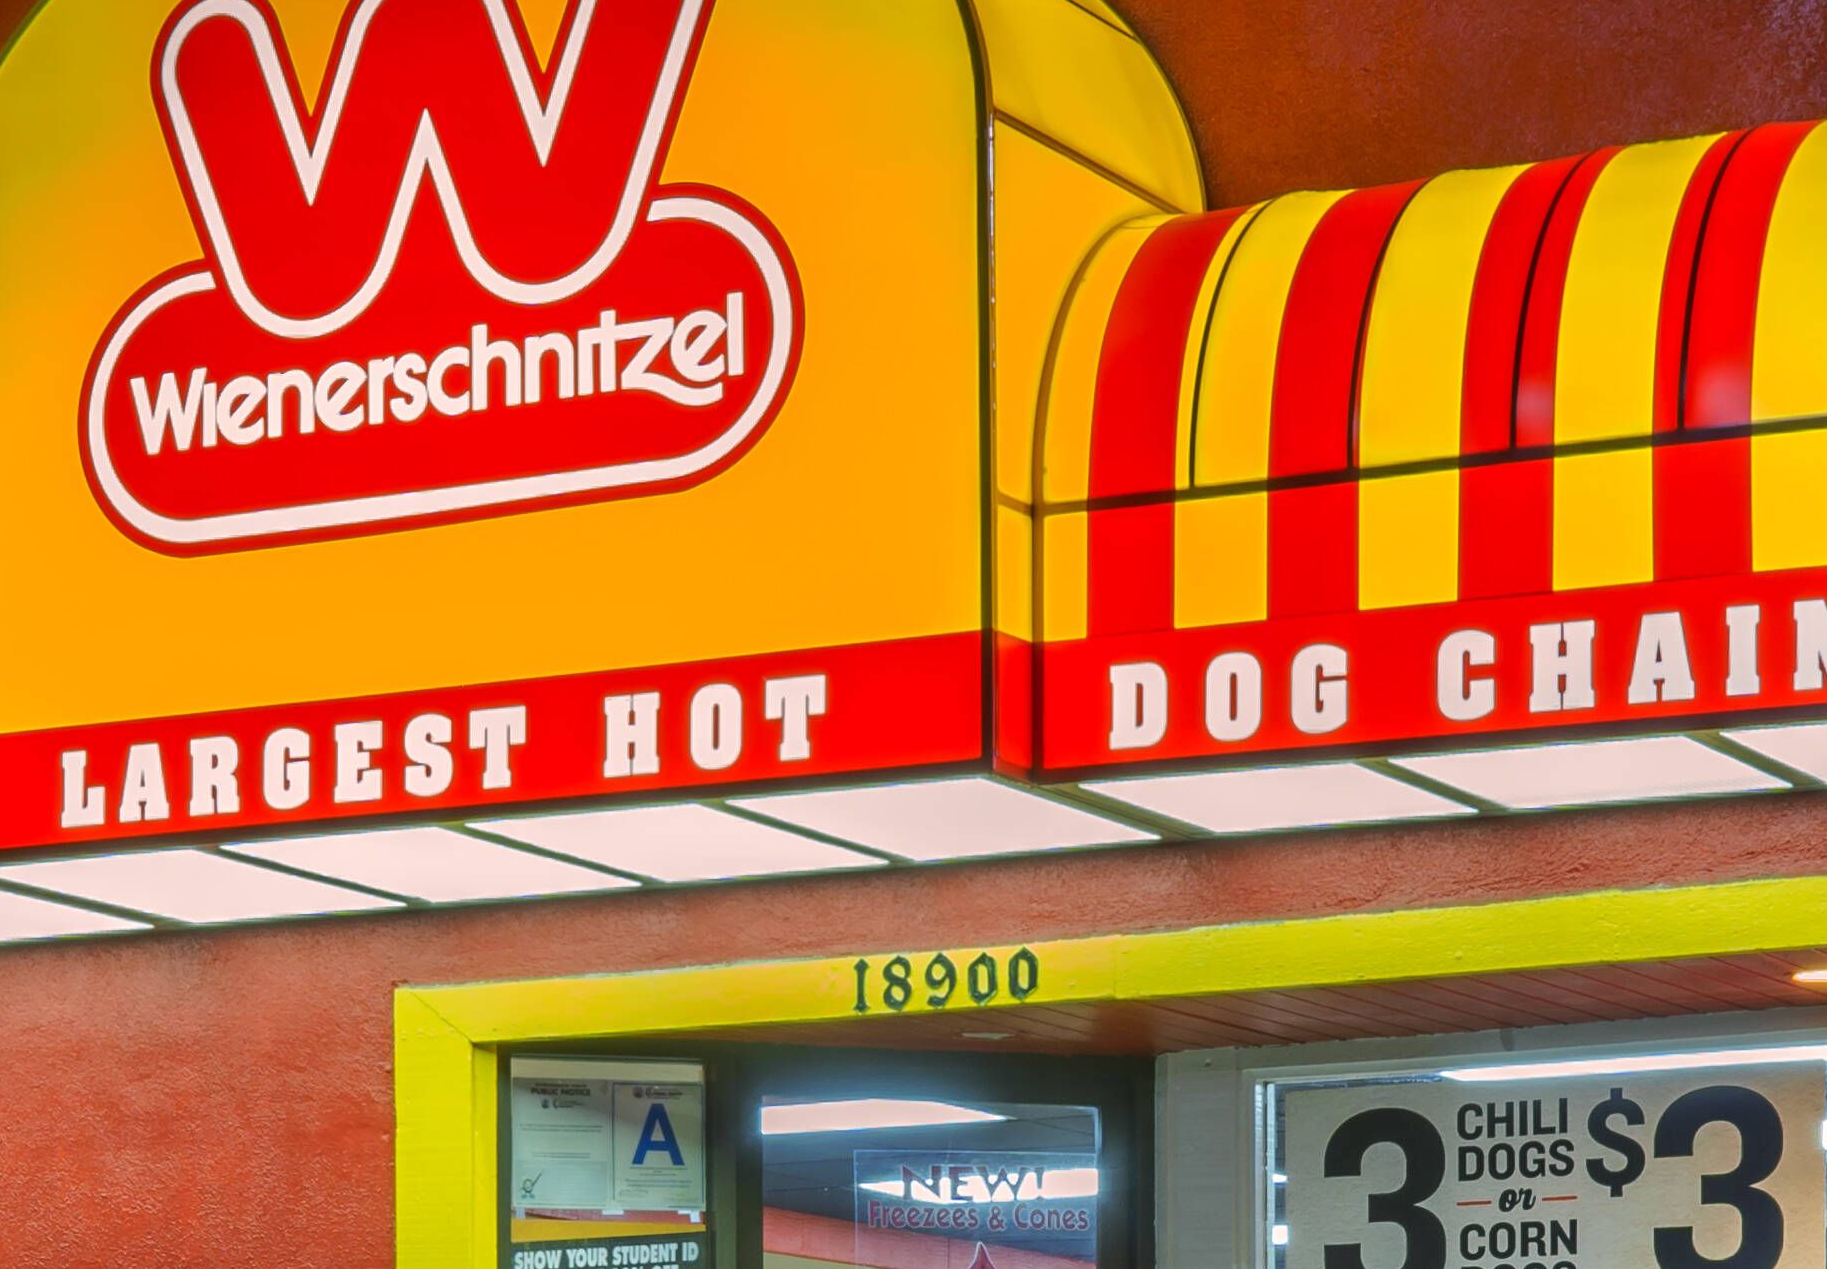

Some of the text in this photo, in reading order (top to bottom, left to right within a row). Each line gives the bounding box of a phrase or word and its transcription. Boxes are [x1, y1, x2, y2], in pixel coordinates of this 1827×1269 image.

[130, 291, 744, 456] Wienerschnitzel
[1108, 643, 1350, 750] DOG
[60, 674, 827, 828] LARGEST HOT
[853, 946, 1039, 1013] 18900
[631, 1103, 686, 1166] A
[1456, 1098, 1570, 1142] CHILI
[901, 1163, 1045, 1202] NEW!
[1457, 1139, 1575, 1183] DOGS
[868, 1200, 1089, 1231] Freezees & Cones
[1497, 1183, 1537, 1213] or
[566, 1247, 608, 1269] YOUR
[612, 1243, 678, 1266] STUDENT
[681, 1241, 700, 1262] ID
[1459, 1218, 1578, 1262] CORN
